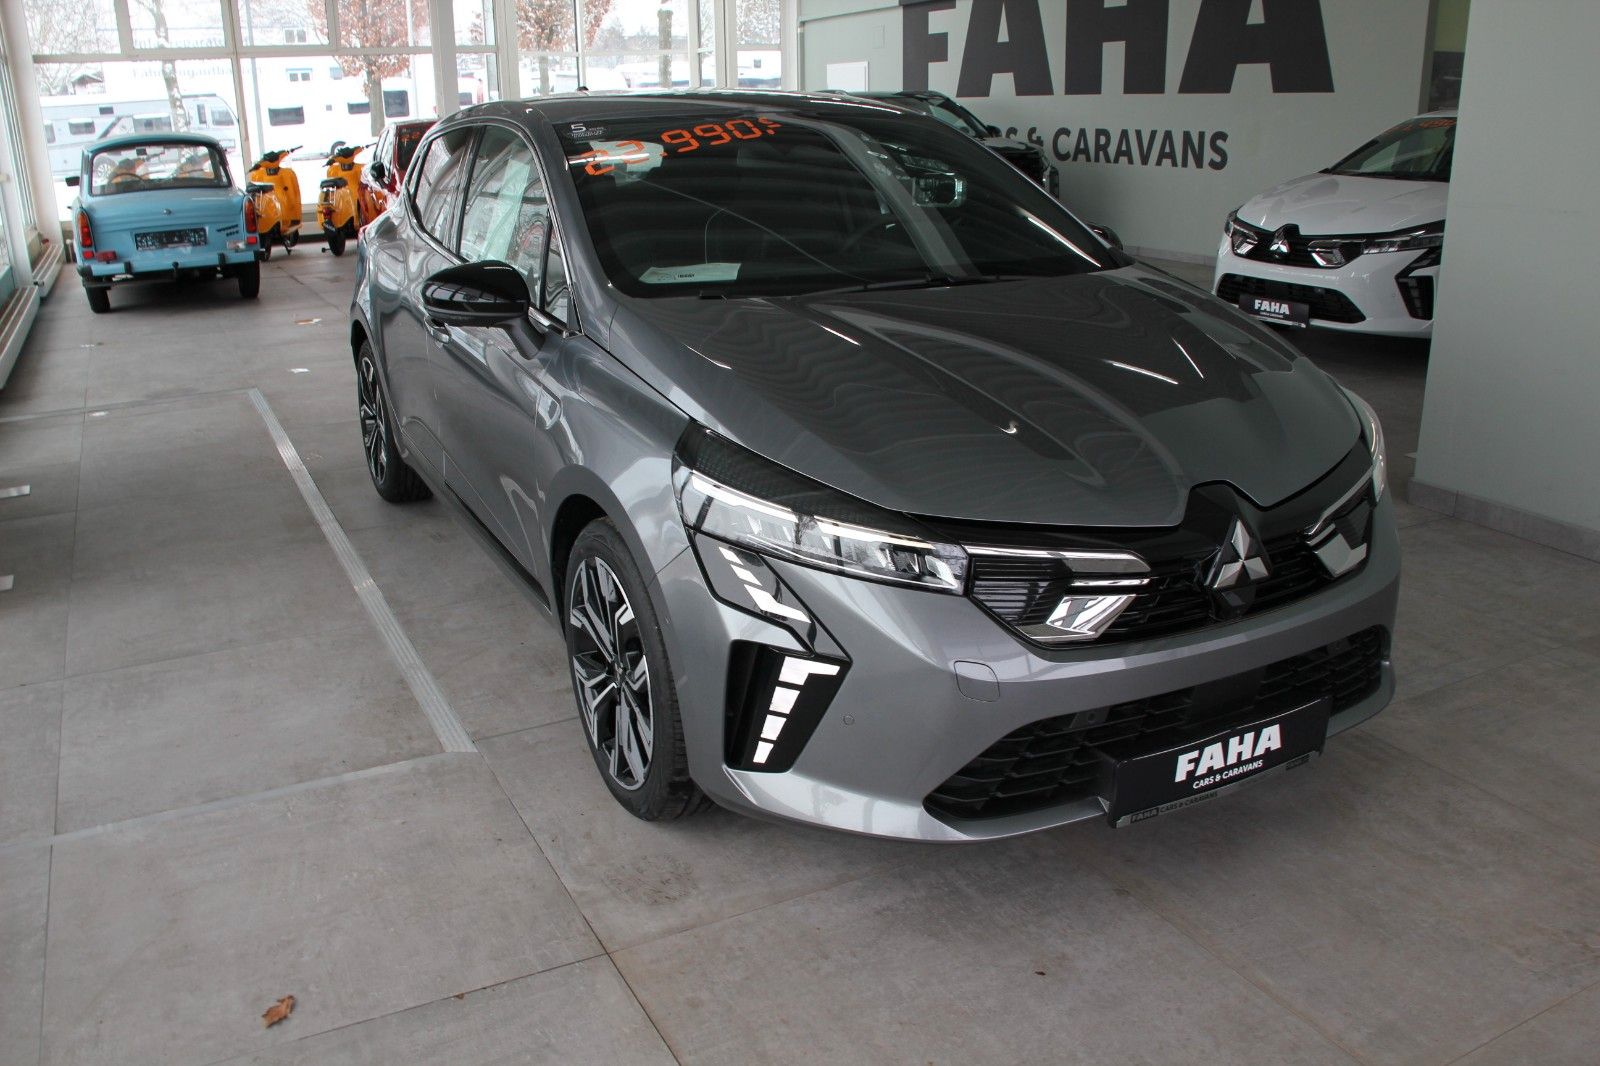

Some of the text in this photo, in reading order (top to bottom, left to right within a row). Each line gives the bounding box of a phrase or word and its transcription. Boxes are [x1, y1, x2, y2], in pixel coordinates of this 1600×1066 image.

[902, 0, 1334, 97] FAHA
[1052, 127, 1230, 171] CARAVANS
[1254, 299, 1290, 315] FAHA
[1174, 724, 1282, 783] FAHA
[1192, 759, 1264, 789] CARS & CARAVANS
